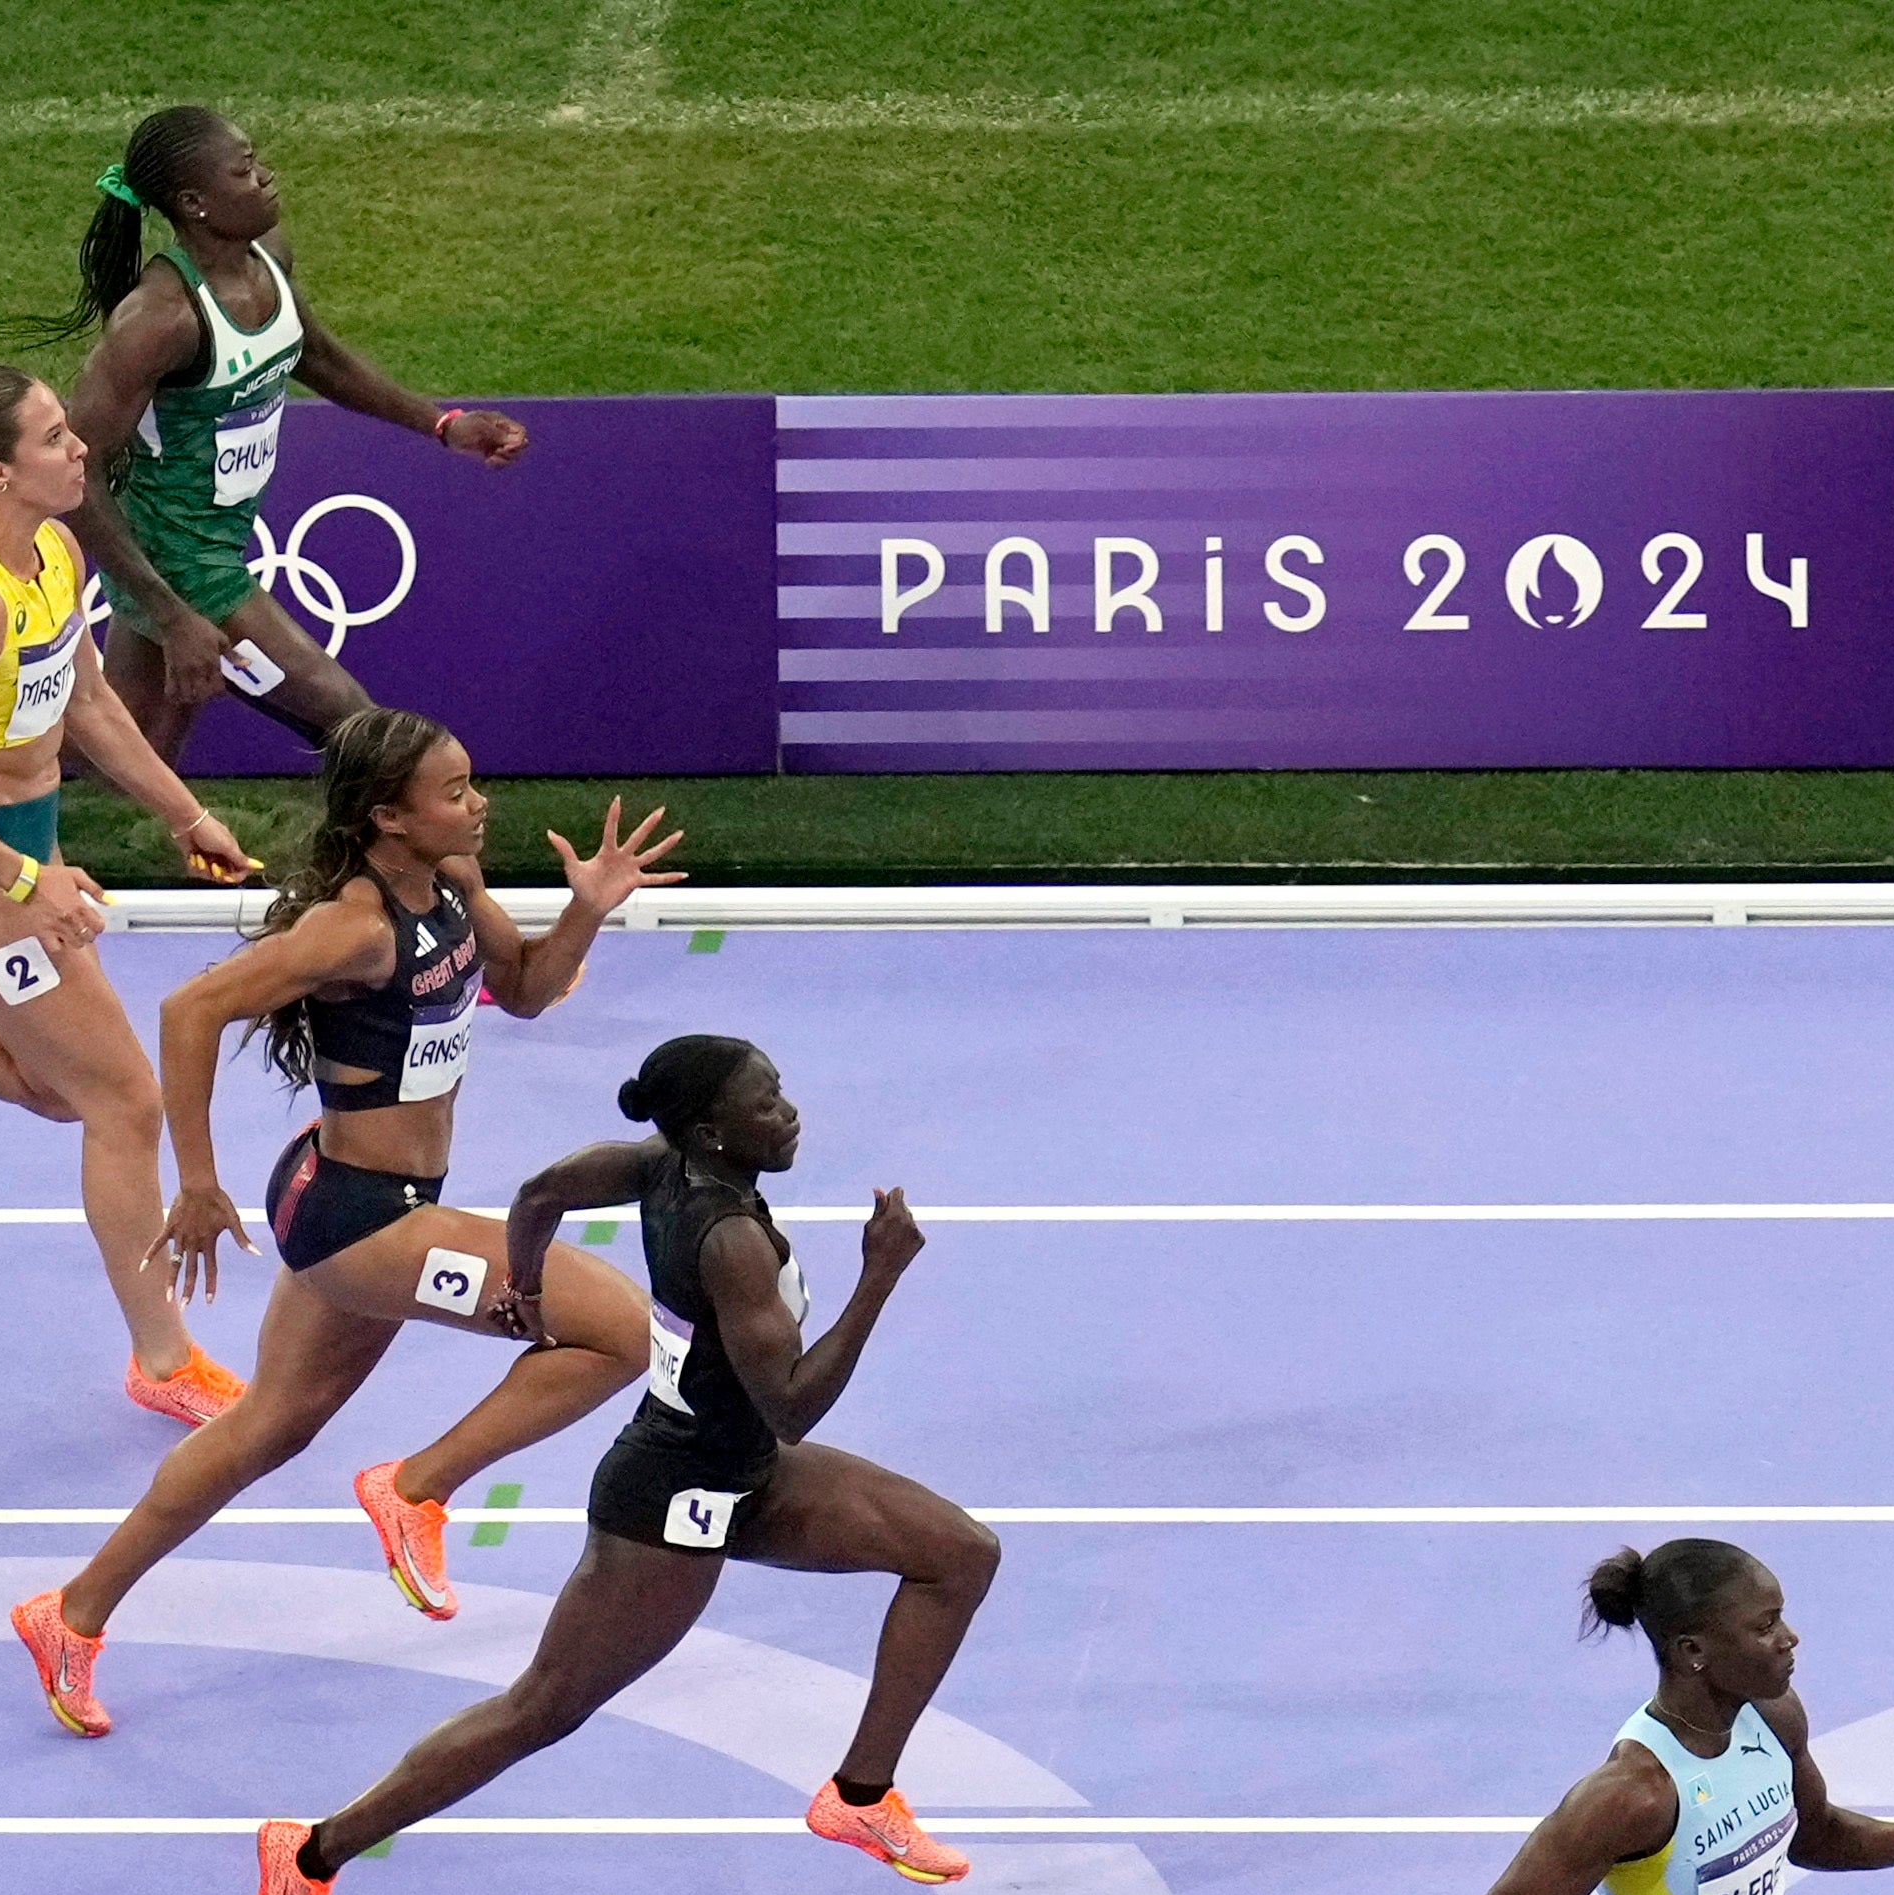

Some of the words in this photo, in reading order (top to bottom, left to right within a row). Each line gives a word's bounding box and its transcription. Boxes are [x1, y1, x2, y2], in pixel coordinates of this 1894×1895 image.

[5, 955, 40, 991] 2
[411, 954, 455, 996] GREAT
[433, 1269, 469, 1297] 3
[688, 1498, 713, 1535] 4
[1694, 1806, 1744, 1856] SAINT
[1747, 1780, 1791, 1817] LUCIA
